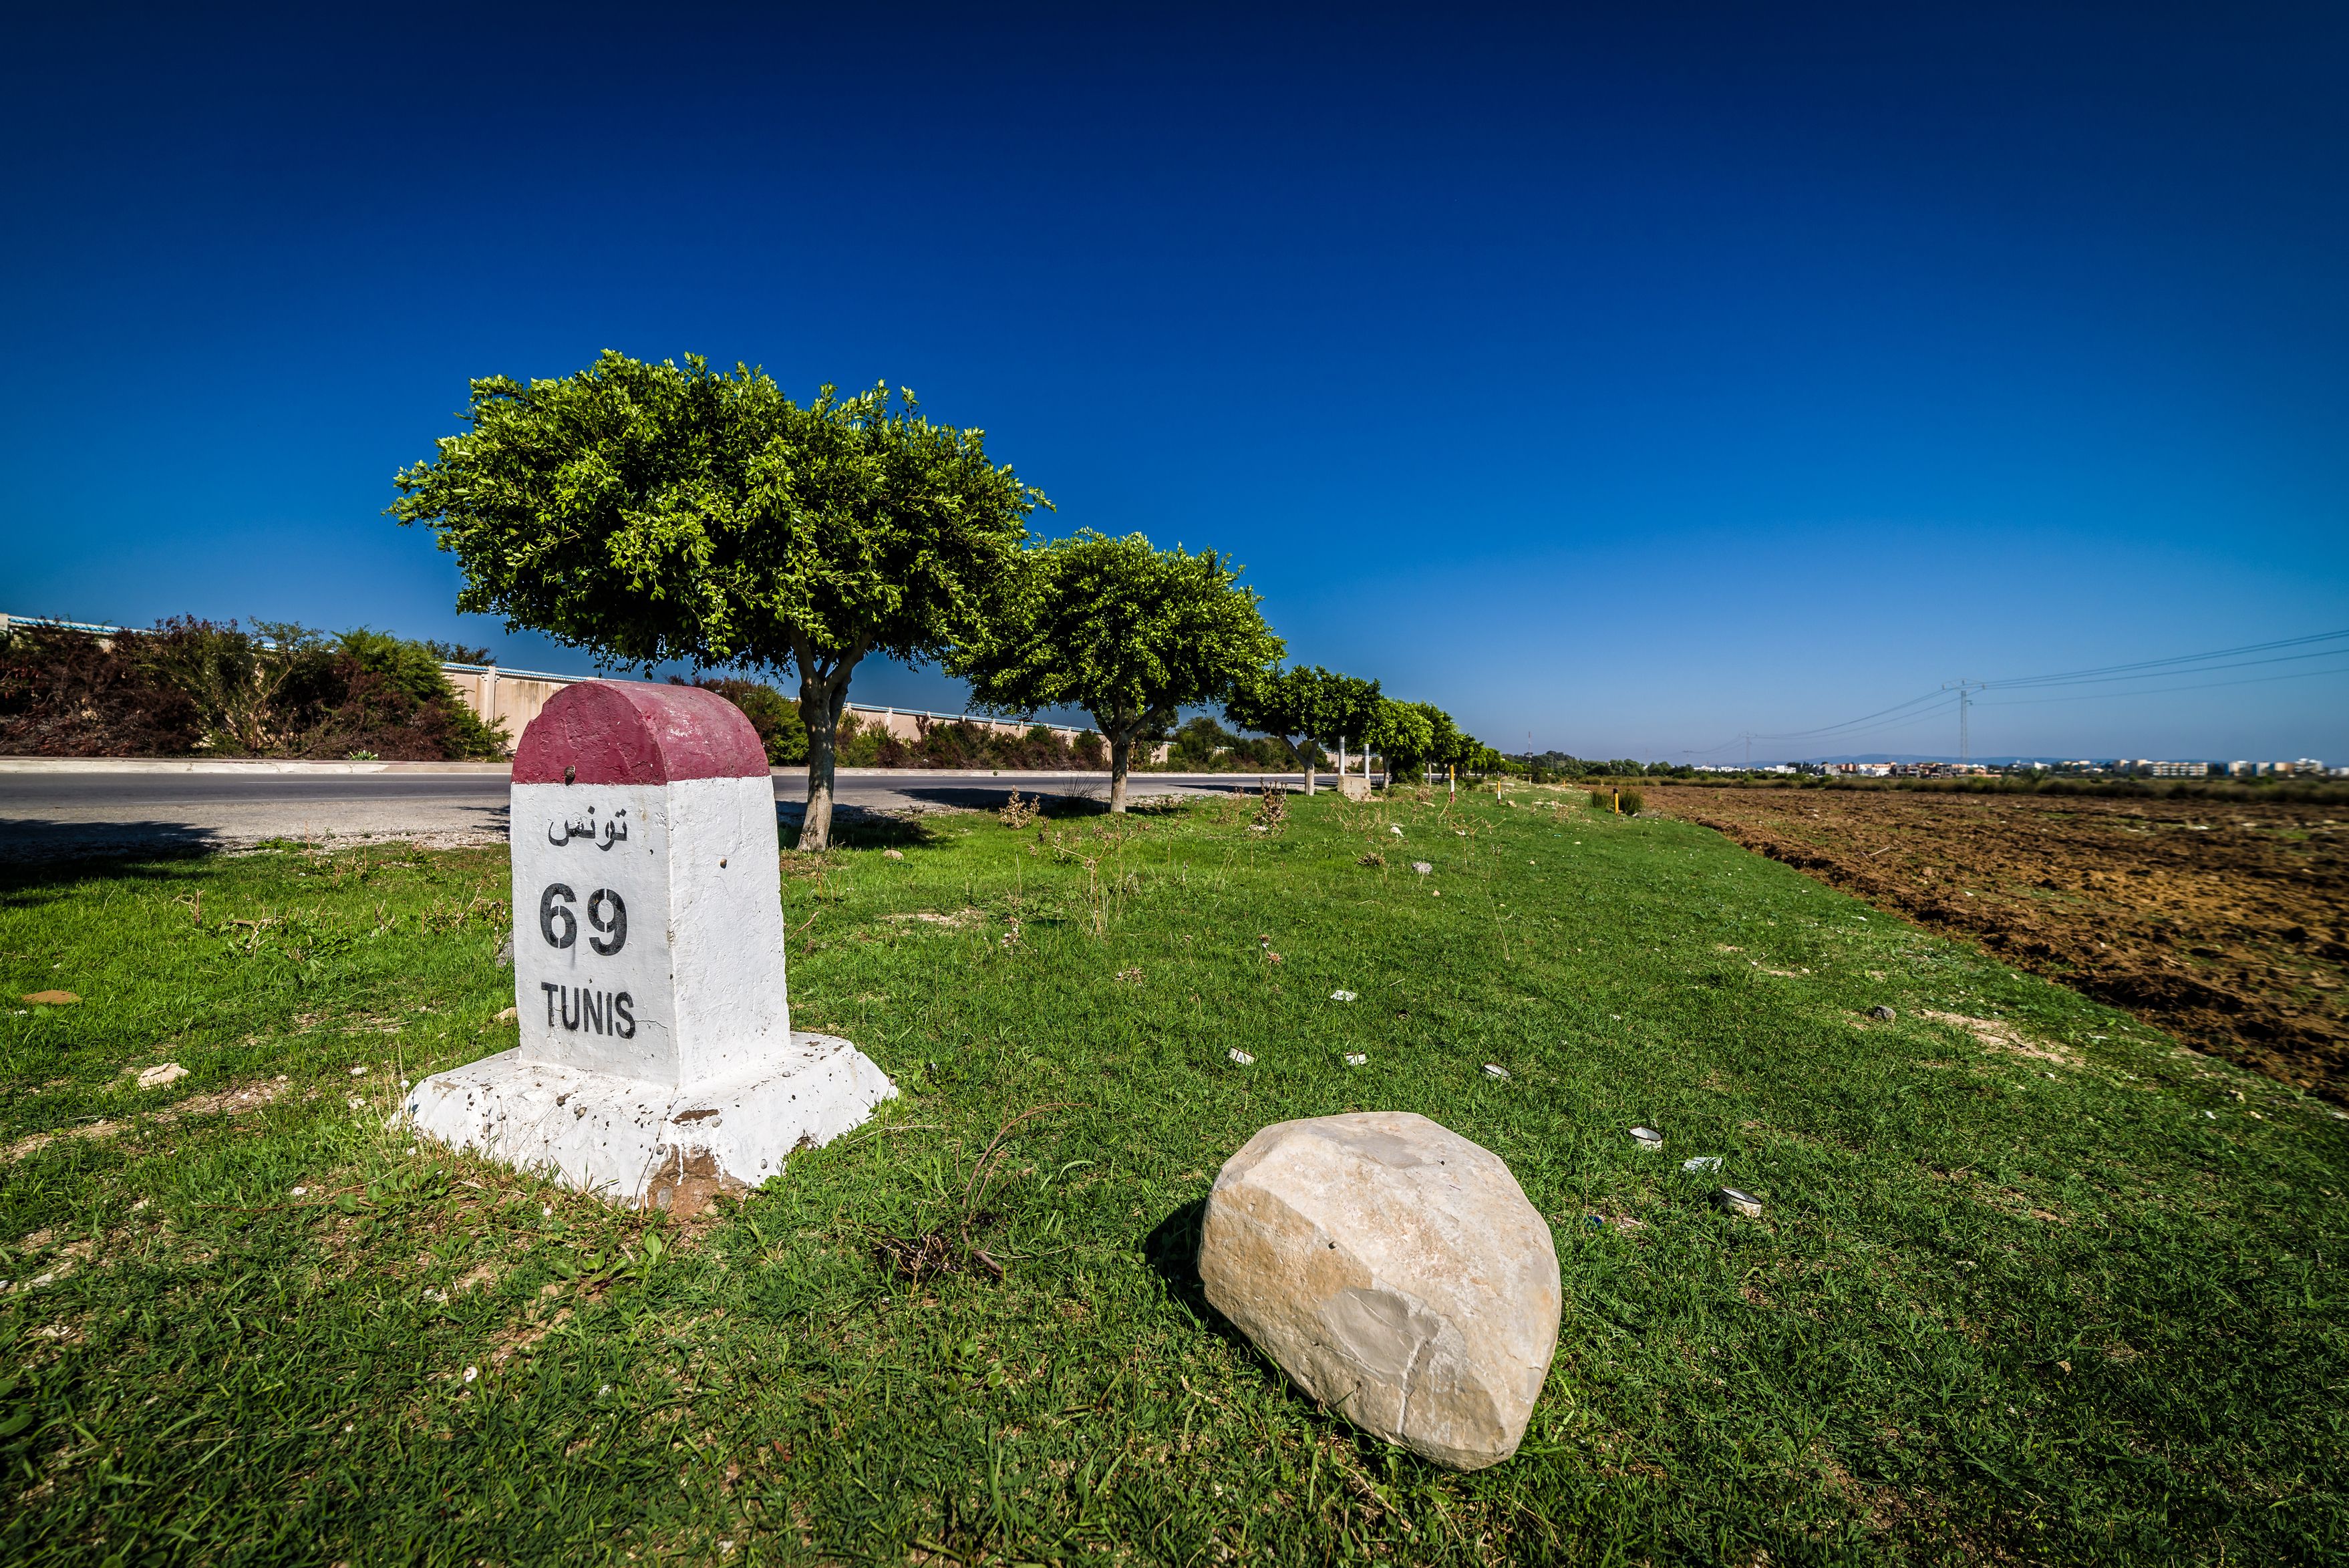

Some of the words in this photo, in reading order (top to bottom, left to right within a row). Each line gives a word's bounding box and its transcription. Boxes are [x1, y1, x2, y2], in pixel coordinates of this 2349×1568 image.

[548, 806, 627, 852] تونس
[540, 883, 627, 956] 69
[541, 982, 635, 1040] TUNIS
